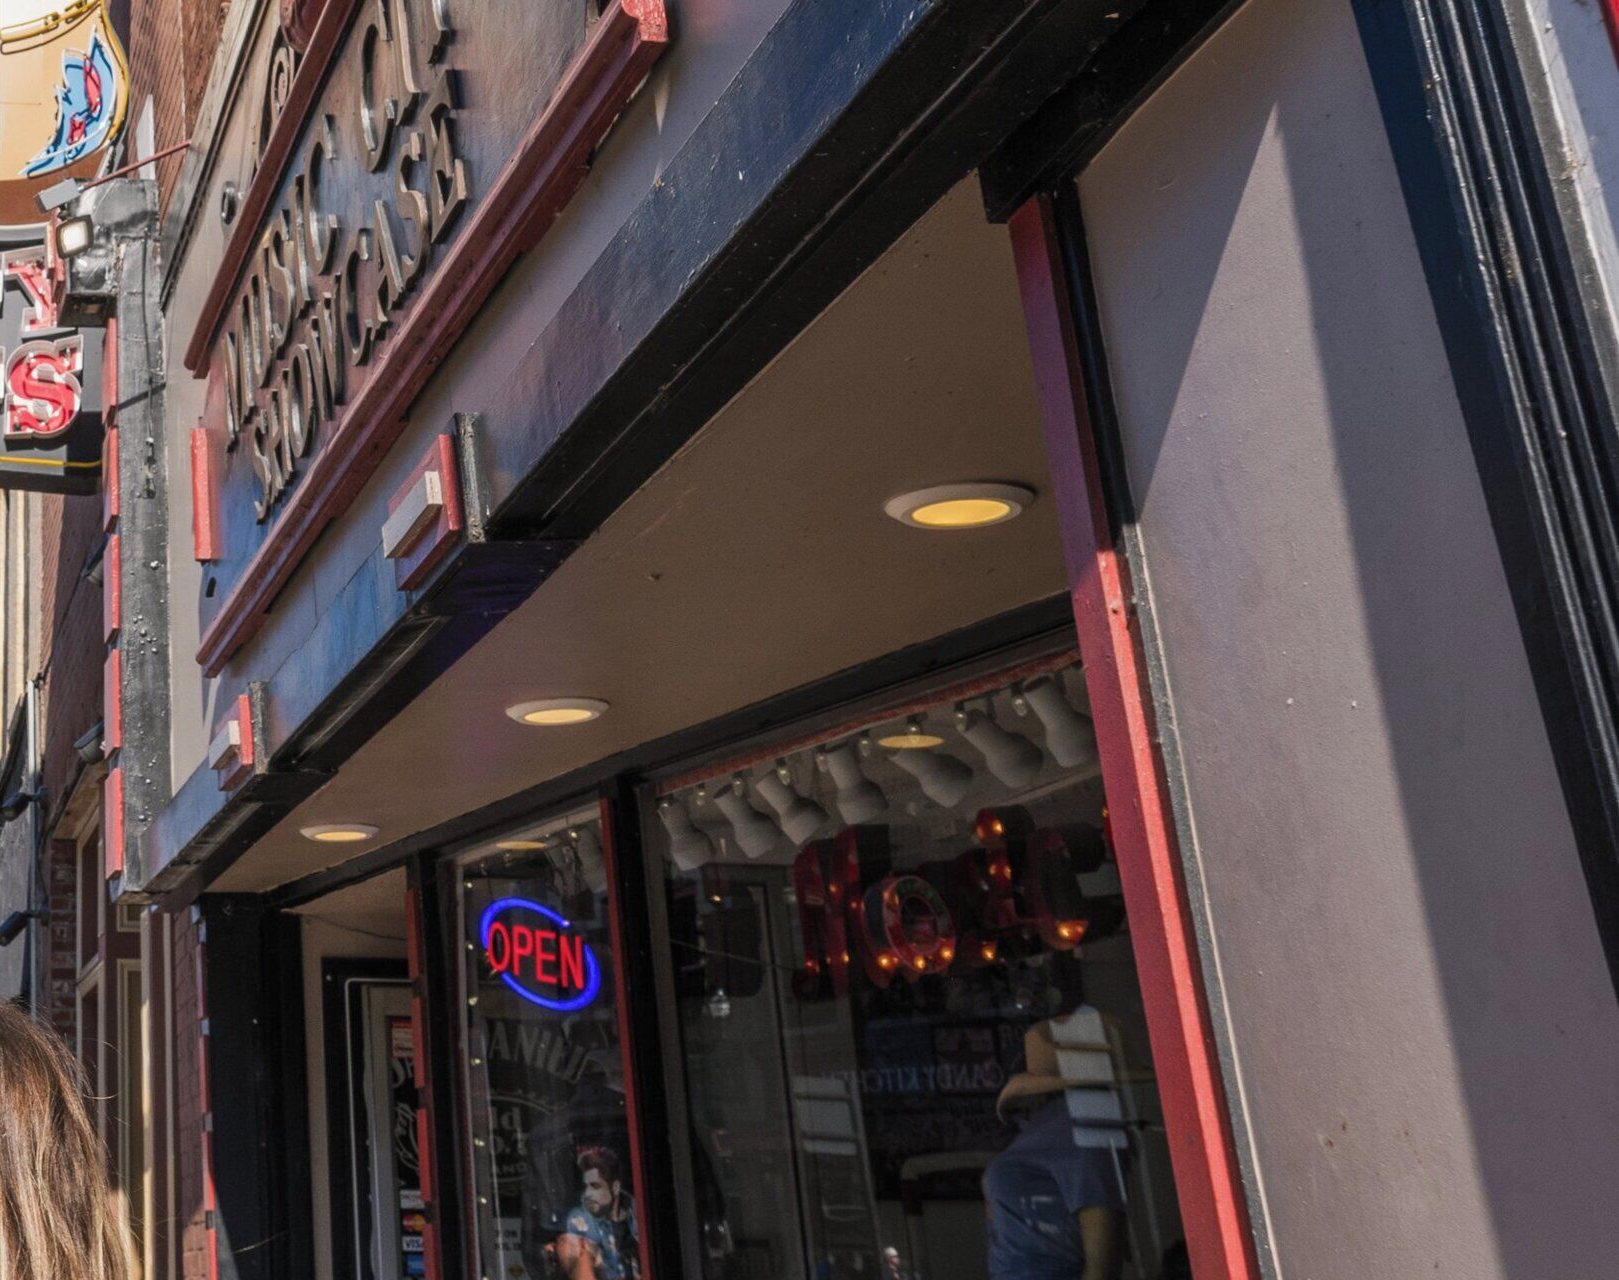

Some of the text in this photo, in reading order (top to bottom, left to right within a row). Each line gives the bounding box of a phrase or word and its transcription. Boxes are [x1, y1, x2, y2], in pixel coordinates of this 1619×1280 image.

[223, 113, 341, 454] MUSIC
[252, 68, 468, 524] SHOWCASE
[487, 921, 585, 990] OPEN
[404, 1237, 424, 1250] VIS
